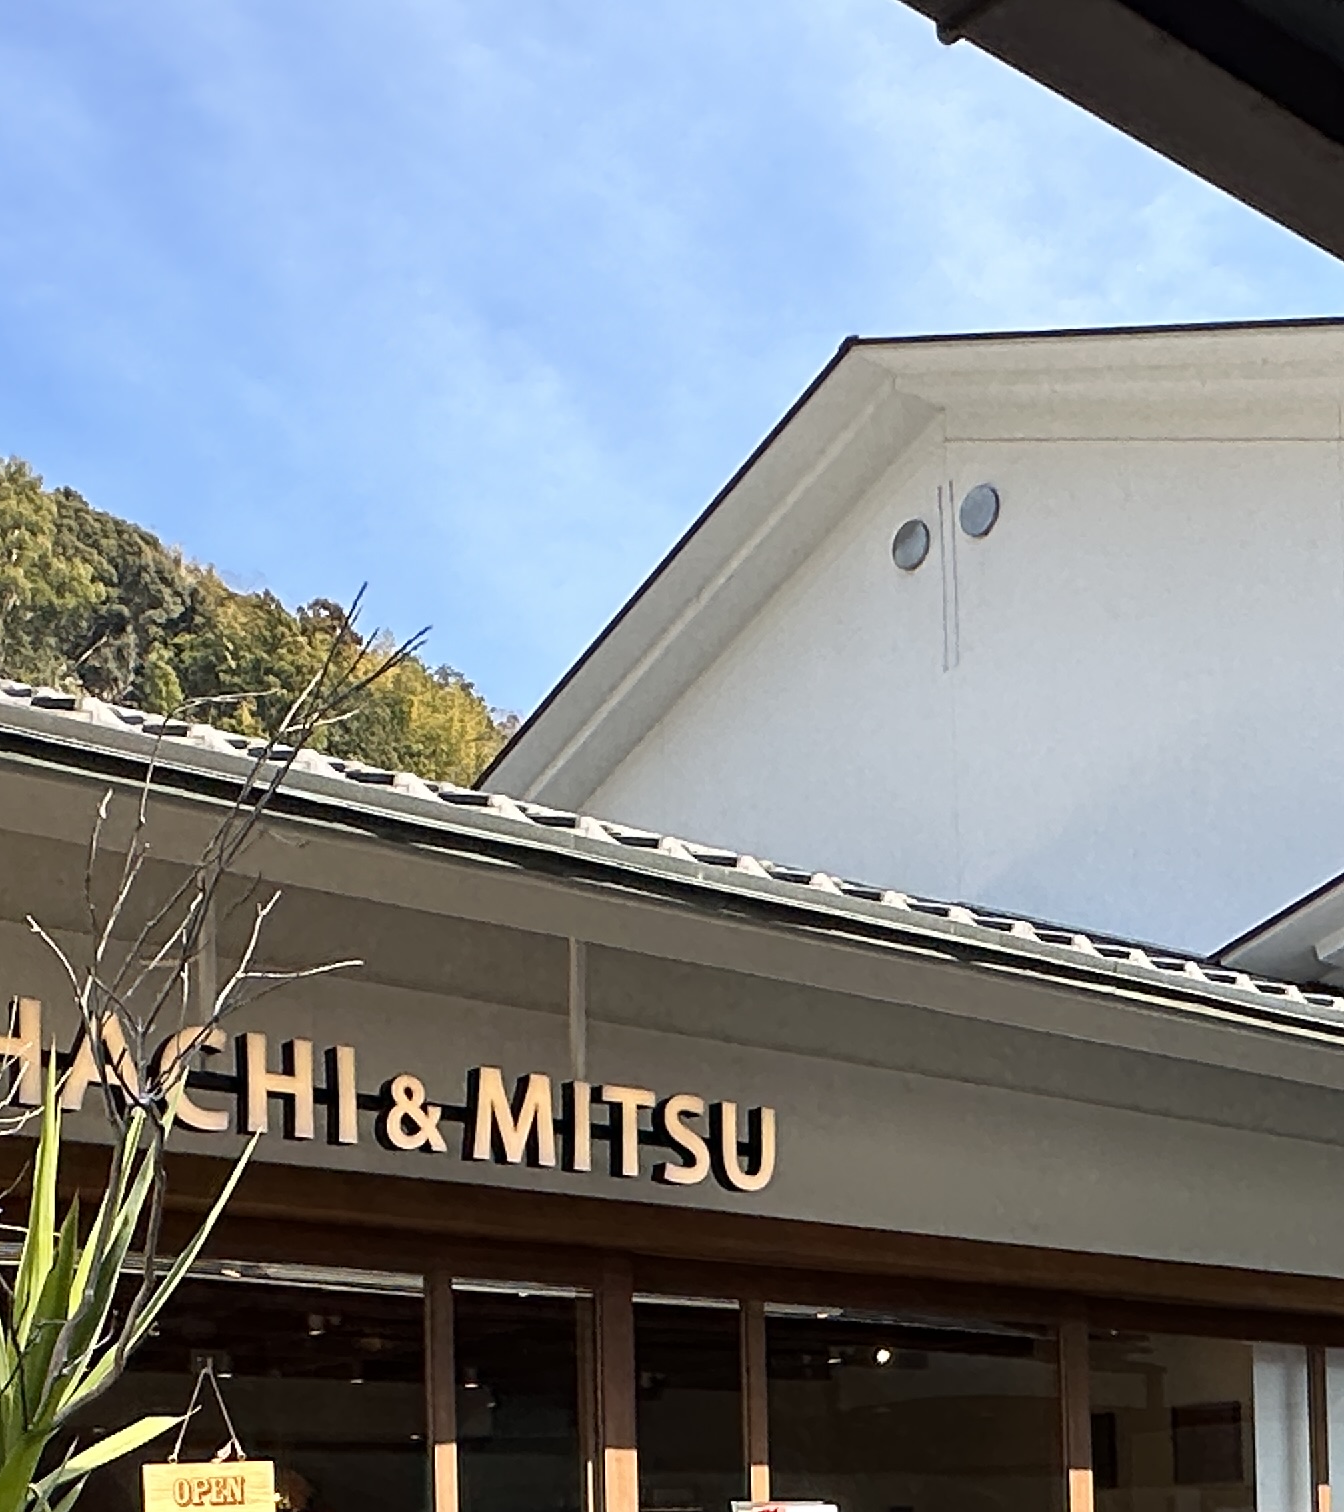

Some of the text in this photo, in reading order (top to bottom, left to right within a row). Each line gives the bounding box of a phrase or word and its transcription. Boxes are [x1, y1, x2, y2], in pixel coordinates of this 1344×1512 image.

[382, 1073, 448, 1153] &
[470, 1065, 778, 1192] MITSU
[173, 1476, 246, 1507] OPEN
